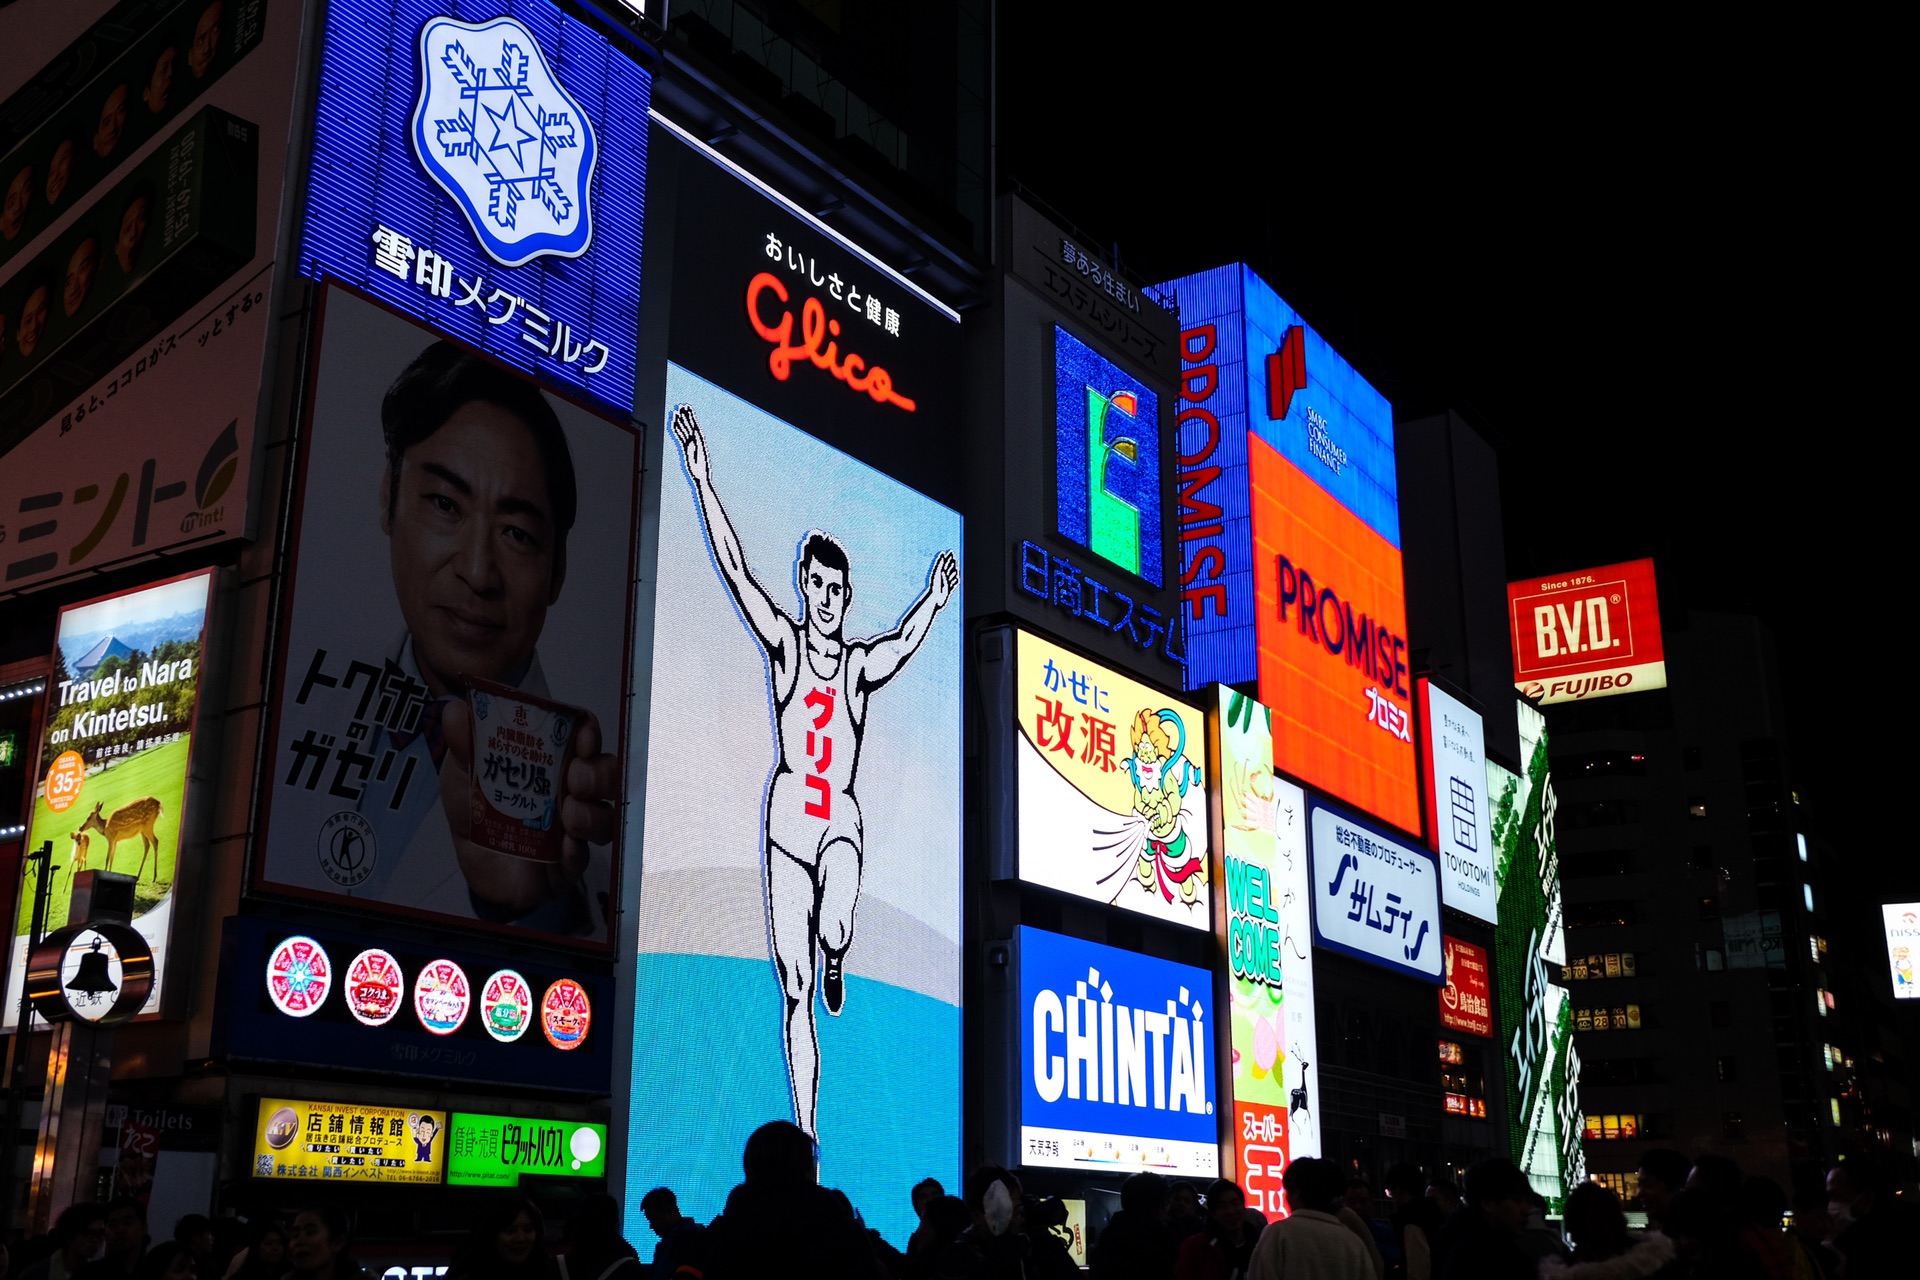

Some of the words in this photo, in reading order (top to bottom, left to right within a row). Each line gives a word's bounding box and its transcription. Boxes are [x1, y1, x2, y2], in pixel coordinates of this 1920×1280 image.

[372, 224, 609, 374] 雪印メグミルク
[765, 232, 901, 338] おいしさと健康
[1062, 240, 1141, 315] 夢ある住まい
[1045, 266, 1157, 365] エステムシリーズ
[746, 272, 917, 413] Glico
[1307, 406, 1328, 434] SMBC
[1308, 422, 1348, 466] CONSUMER
[1309, 438, 1341, 476] FINANCE
[1541, 582, 1568, 591] Since
[1570, 576, 1596, 586] 1876.
[1278, 554, 1408, 700] PROMISE
[1534, 597, 1620, 658] B.V.D.
[58, 669, 121, 706] Travel
[123, 676, 138, 693] to
[140, 658, 192, 688] Nara
[296, 648, 428, 734] トクホ
[1043, 658, 1110, 713] かぜに
[1550, 673, 1633, 698] FUJIBO
[51, 729, 69, 745] on
[72, 702, 169, 739] Kintetsu.
[347, 722, 368, 741] の
[513, 705, 531, 727] 恵
[1035, 695, 1117, 773] 改源
[1365, 687, 1411, 743] プロミス
[286, 730, 417, 810] ガセリ
[804, 686, 836, 820] グリコ
[53, 771, 75, 794] 35
[494, 789, 537, 811] ヨーグルト
[1336, 825, 1422, 875] 総合不動産のプロデューサー
[1226, 855, 1278, 925] WEL
[1347, 879, 1413, 940] サムティ
[1458, 880, 1481, 897] HOLDINGS
[1230, 916, 1281, 985] COME
[1033, 966, 1206, 1114] CHINTAI
[133, 1109, 193, 1131] Toilets
[307, 1113, 404, 1137] 店舗情報館
[308, 1103, 332, 1113] KANSAI
[334, 1106, 357, 1115] INVEST
[360, 1107, 405, 1117] CORPORATION
[1243, 1112, 1282, 1142] スーパー
[306, 1133, 403, 1146] 居抜き店舗総合プロデュース
[454, 1126, 499, 1158] 賃貸・売買
[501, 1123, 564, 1167] ピタットハウス
[277, 1164, 318, 1177] 株式会社
[323, 1166, 383, 1179] 関西インベスト
